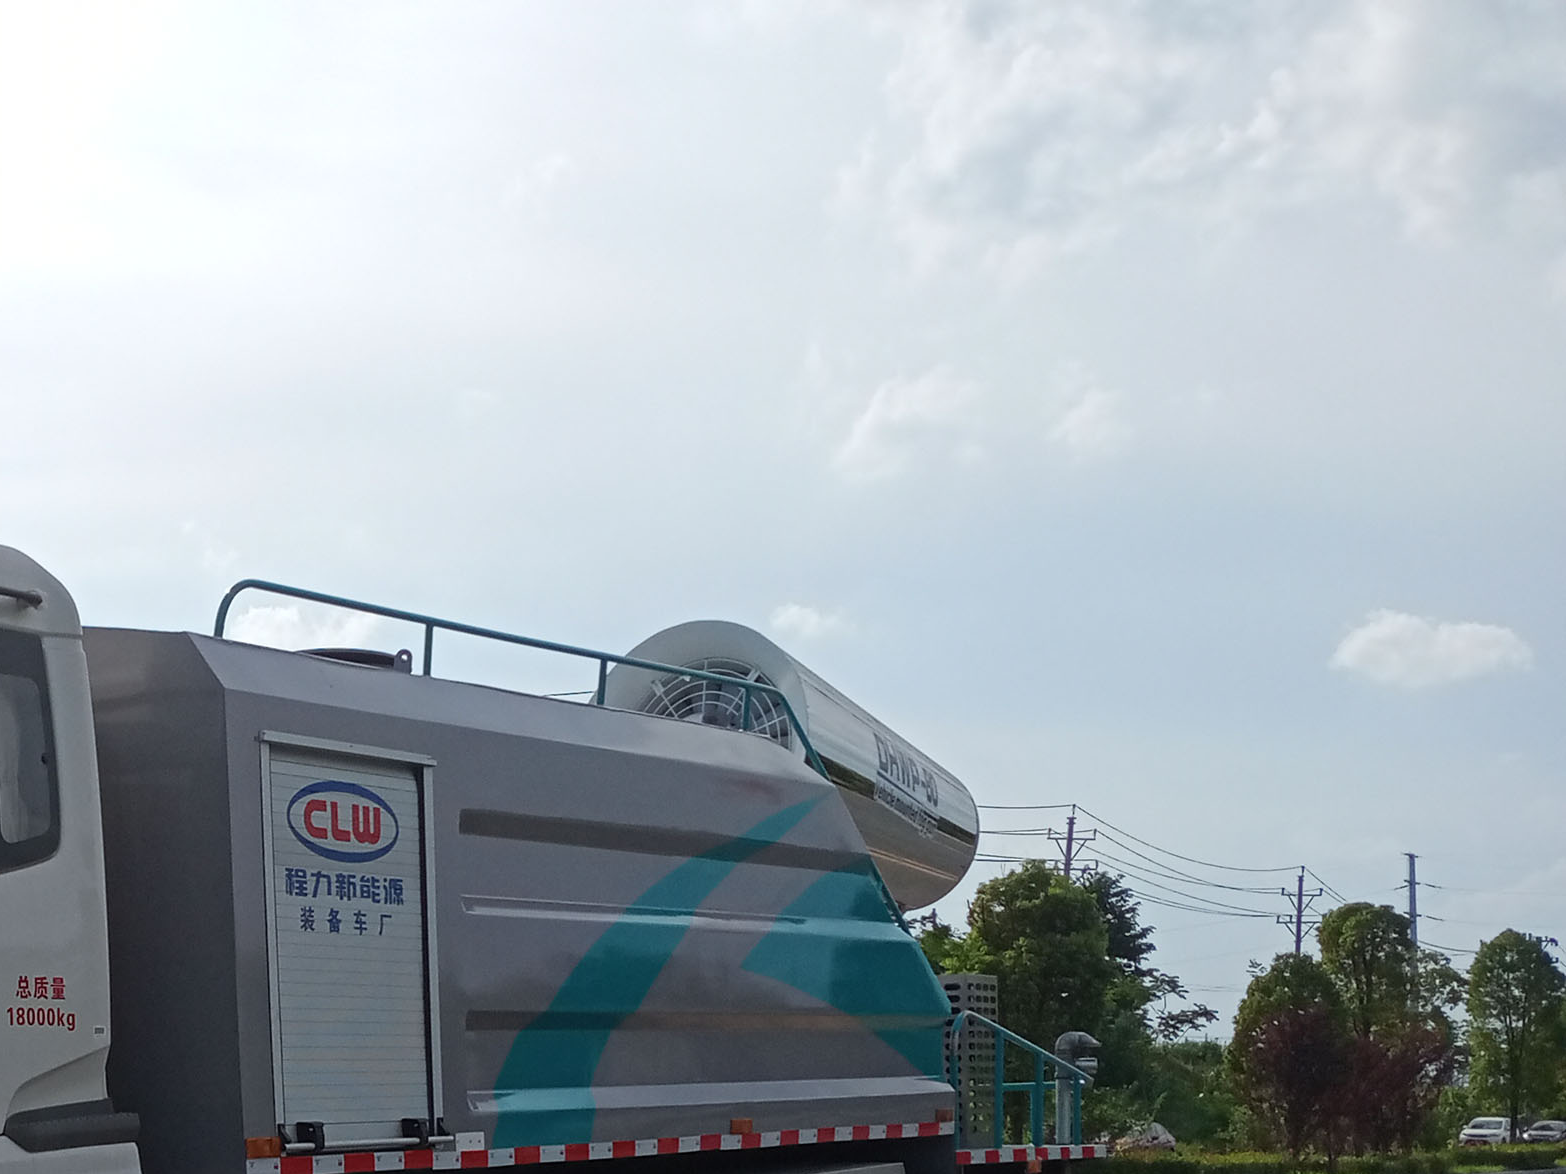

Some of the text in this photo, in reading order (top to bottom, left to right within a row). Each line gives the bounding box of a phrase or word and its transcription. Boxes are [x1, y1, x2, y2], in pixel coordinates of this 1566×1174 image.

[303, 799, 381, 845] CLW
[285, 867, 404, 906] 程力新能源
[300, 906, 392, 936] 装备车厂
[16, 975, 66, 1000] 总质量
[6, 1006, 76, 1032] 18000kg
